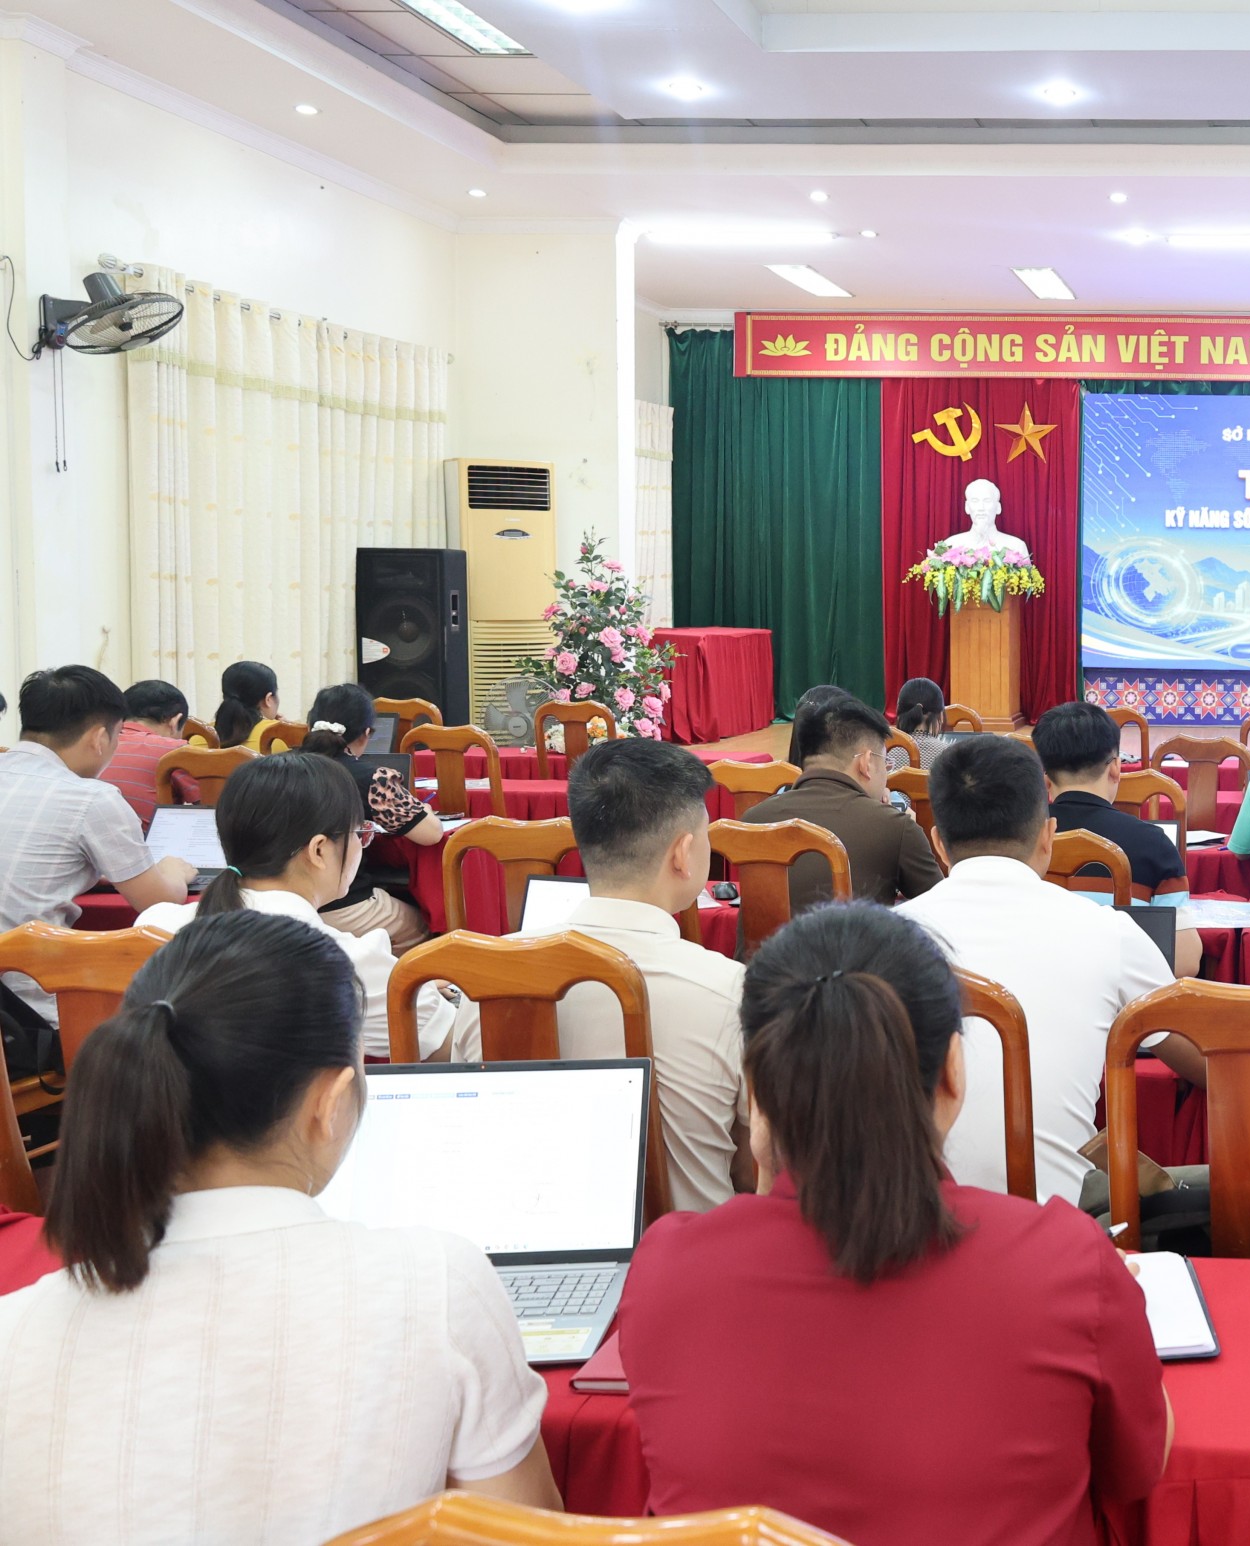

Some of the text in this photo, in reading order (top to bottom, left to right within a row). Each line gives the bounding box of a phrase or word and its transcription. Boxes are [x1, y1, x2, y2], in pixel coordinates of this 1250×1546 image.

[825, 324, 918, 362] ĐẢNG
[930, 327, 1023, 368] CỘNG
[1035, 324, 1105, 363] SẢN
[1117, 329, 1189, 370] VIỆT
[1222, 425, 1243, 442] SỞ
[1165, 506, 1186, 528] KỸ
[1188, 507, 1230, 529] NĂNG
